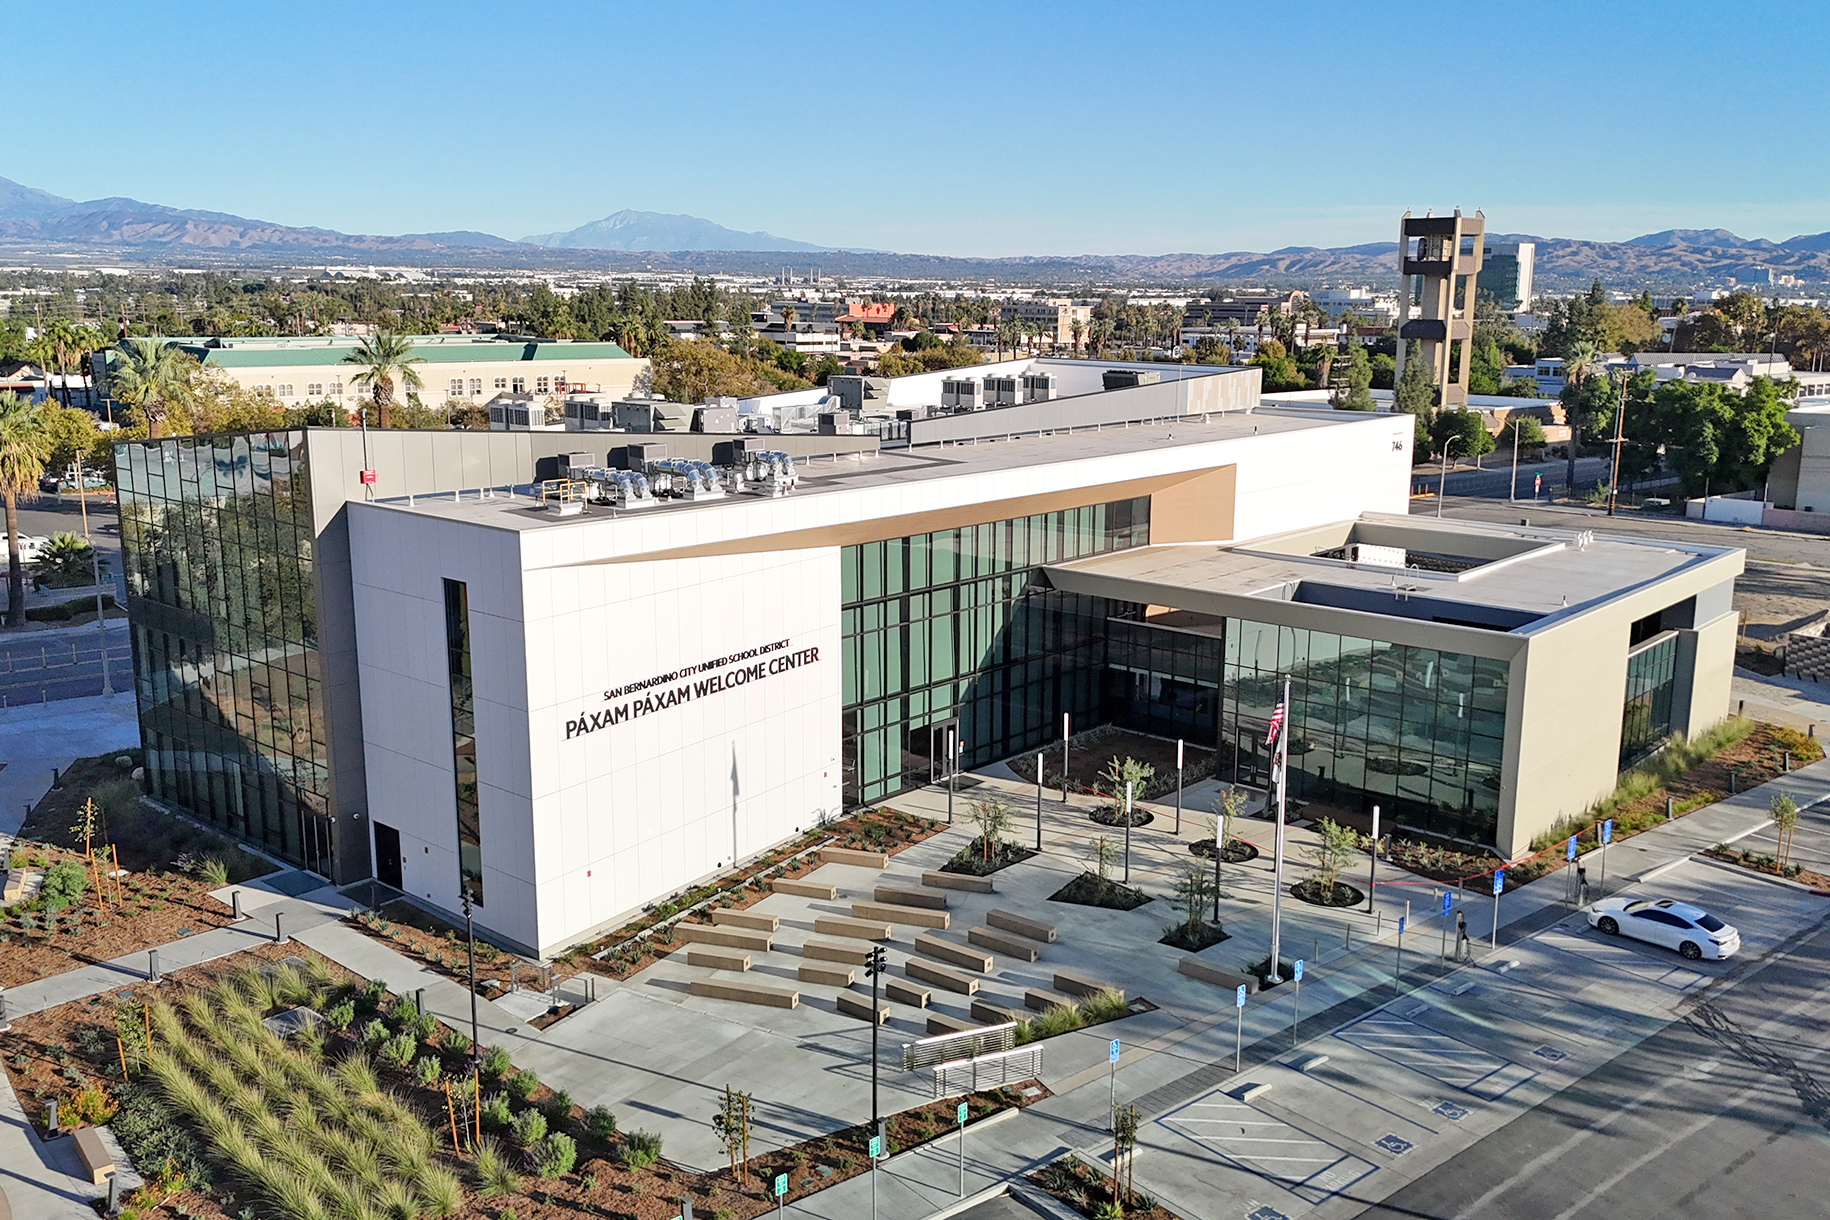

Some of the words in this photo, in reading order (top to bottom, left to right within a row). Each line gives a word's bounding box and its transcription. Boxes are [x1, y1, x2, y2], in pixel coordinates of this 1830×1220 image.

[1391, 440, 1403, 452] 746
[565, 703, 630, 740] PÁXAM
[633, 684, 690, 719] PÁXAM
[693, 661, 767, 699] WELCOME
[768, 646, 819, 676] CENTER
[603, 687, 623, 701] SAN
[623, 671, 679, 695] BERNARDINO
[679, 665, 698, 679] CITY
[698, 656, 728, 673] UNIFIED
[728, 648, 759, 664] SCHOOL
[759, 638, 790, 655] DISTRICT
